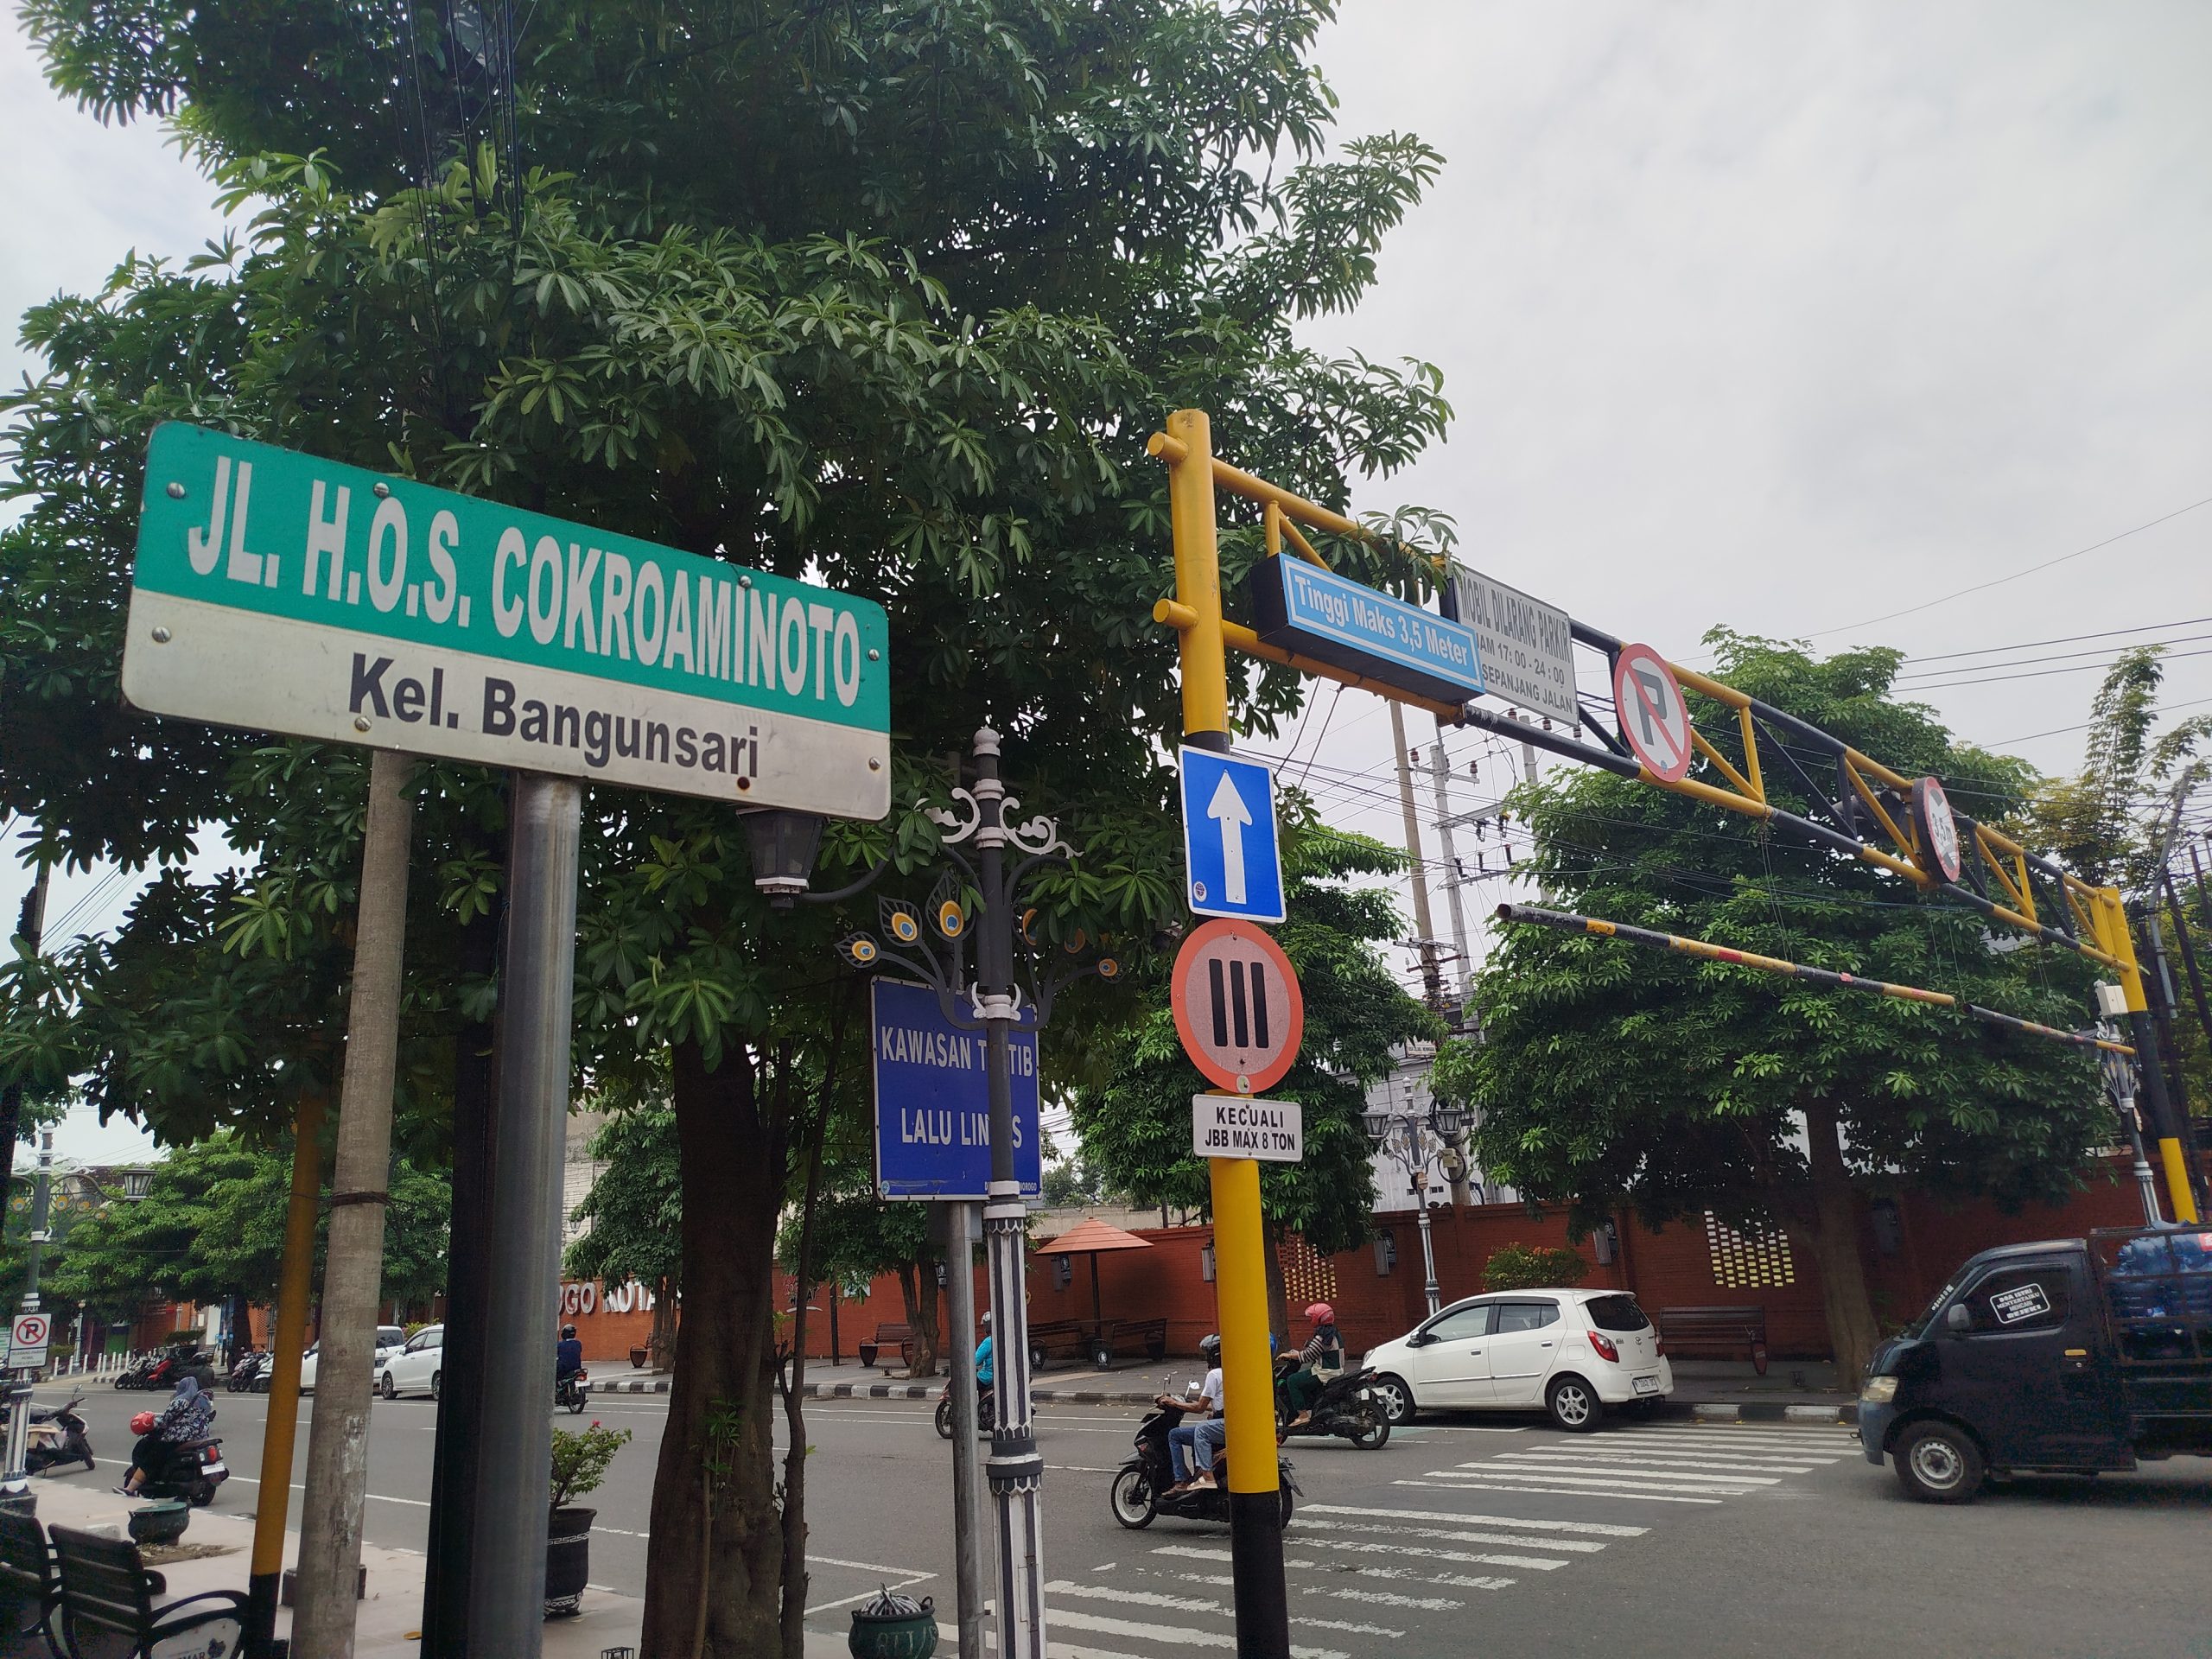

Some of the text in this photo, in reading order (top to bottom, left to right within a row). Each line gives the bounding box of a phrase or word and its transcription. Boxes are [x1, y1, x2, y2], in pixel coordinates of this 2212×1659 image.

[188, 455, 861, 708] JL. H.O.S. COKROAMINOTO
[1294, 575, 1468, 666] Tinggi Maks 3,5 Meter
[1460, 575, 1571, 664] MOBIL DILARANG PARKIR
[1481, 663, 1573, 714] SEPANJANG JALAN
[348, 652, 760, 779] Kel. Bangunsari
[881, 1026, 1033, 1077] KAWASAN TTIB
[901, 1108, 1022, 1148] LALU LINS
[1205, 1128, 1295, 1151] JBB MAX 8 TON
[1216, 1107, 1284, 1128] KECUALI
